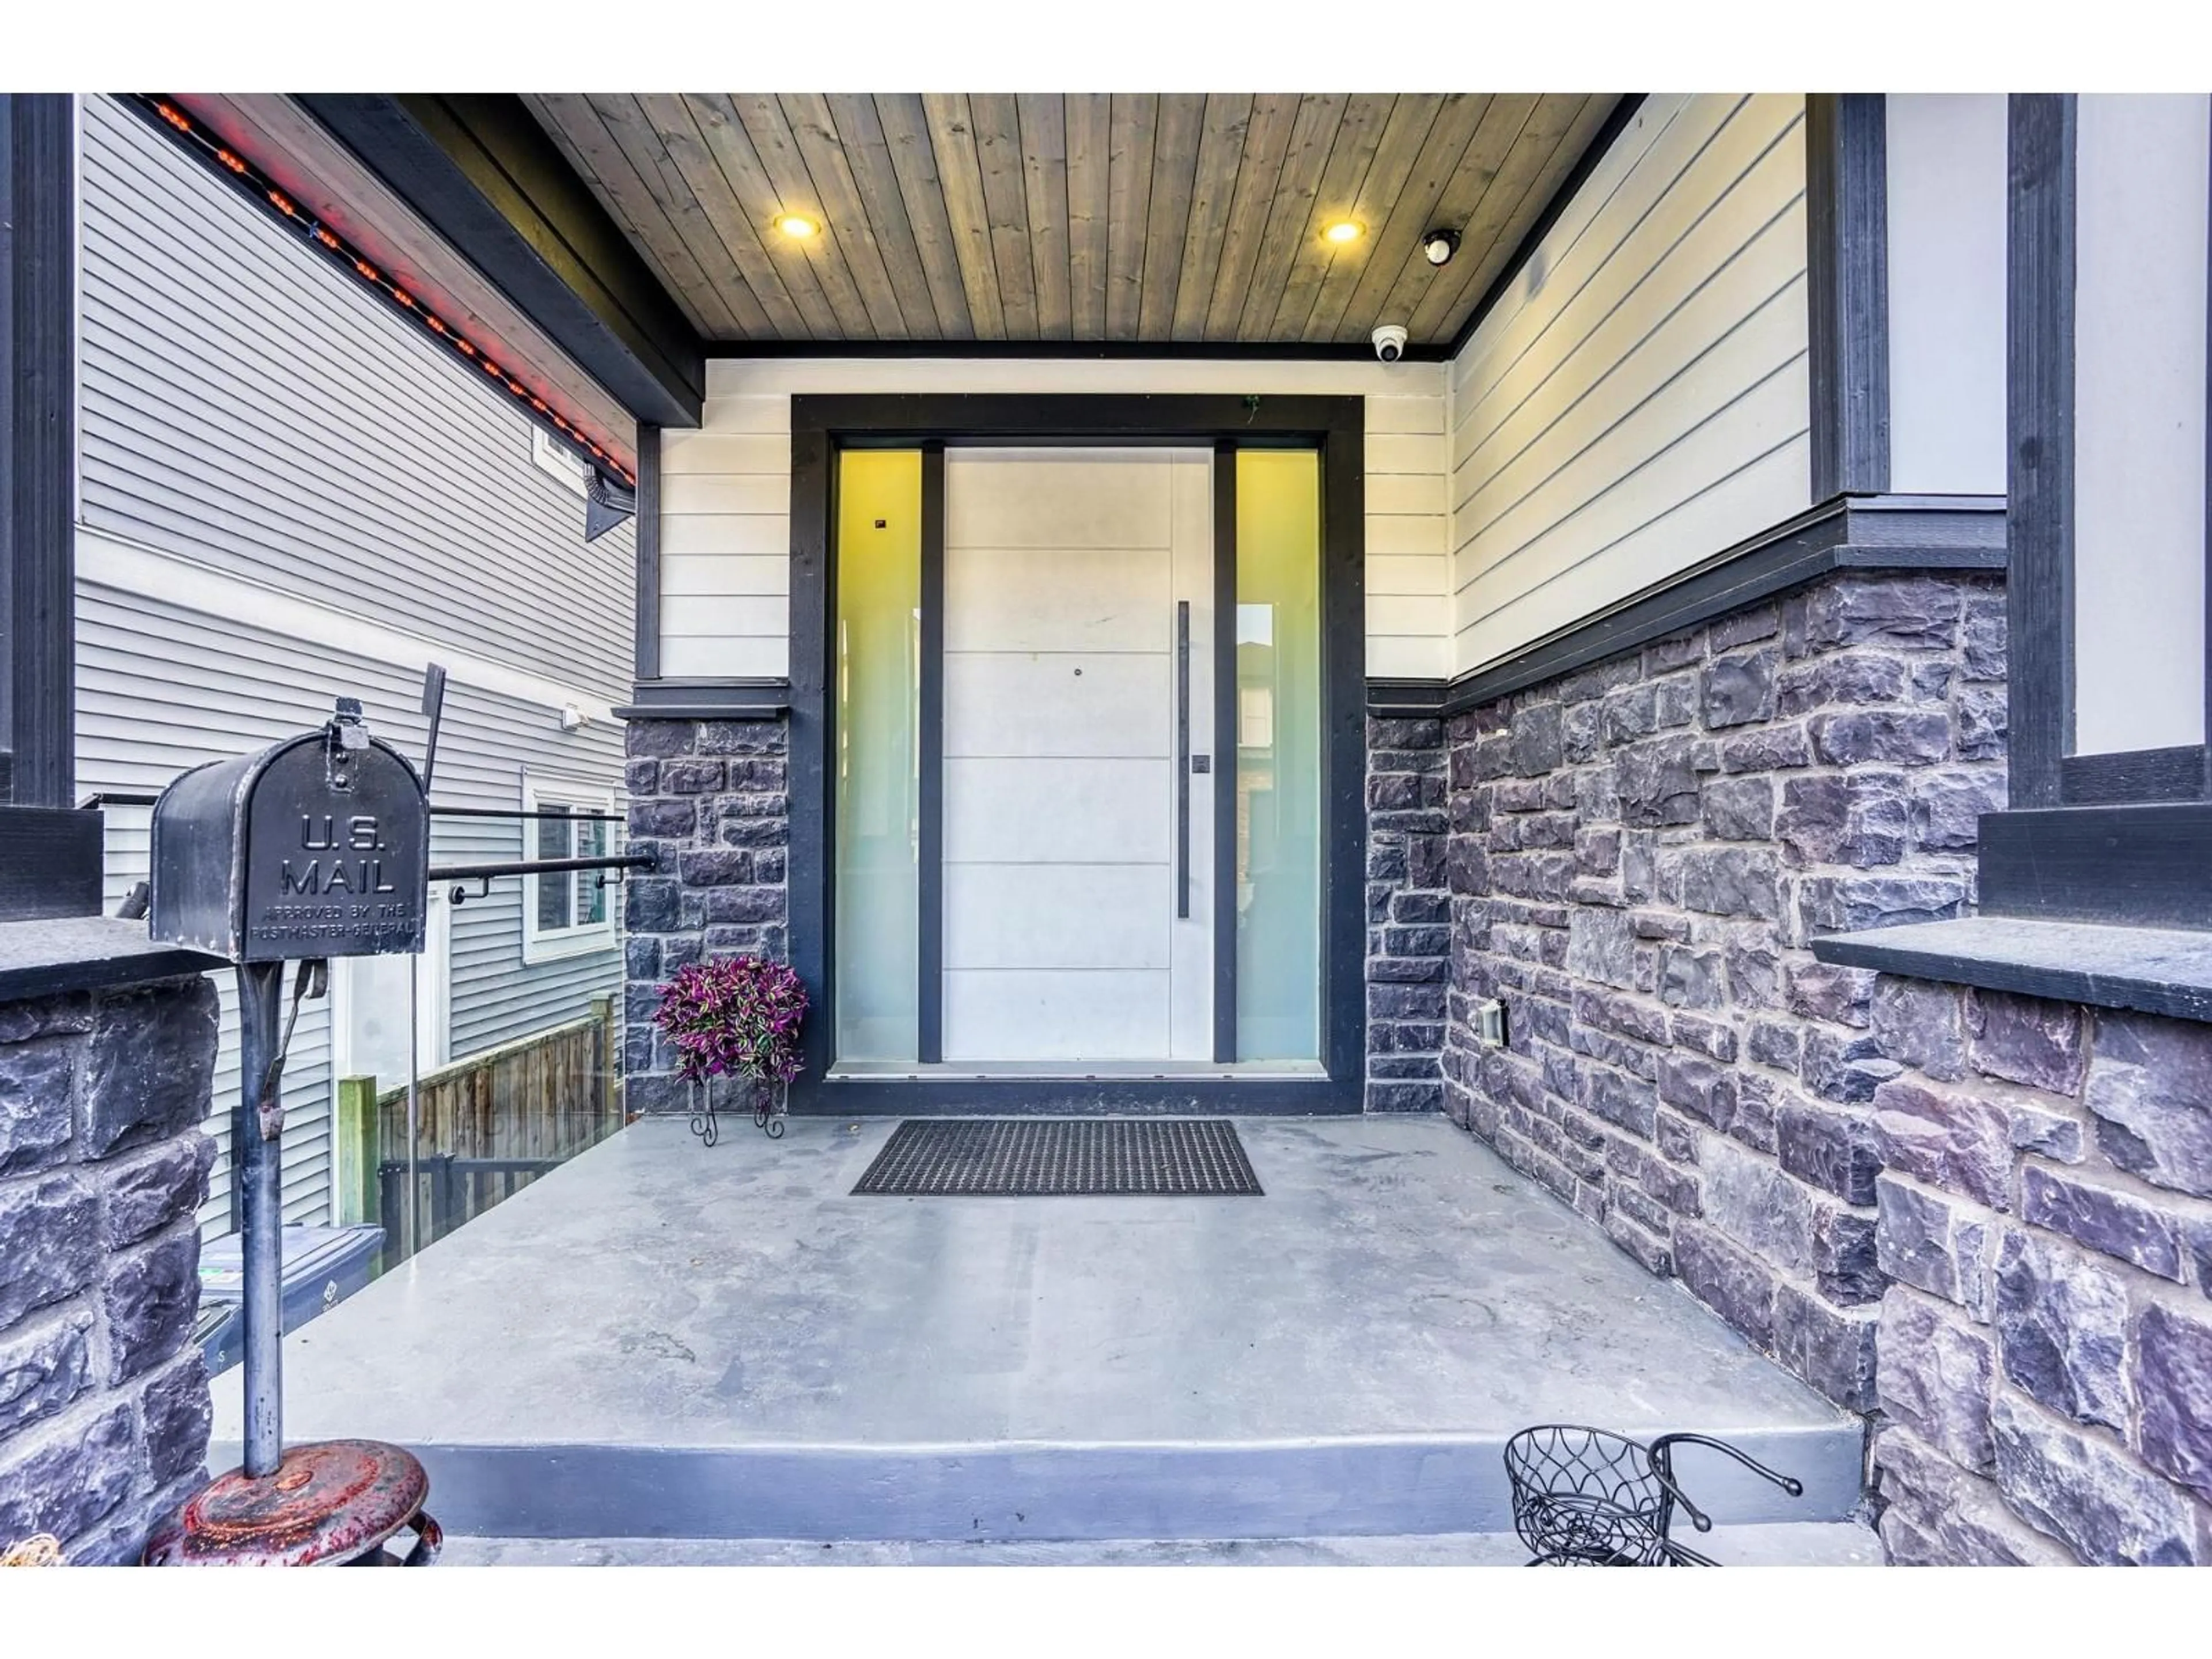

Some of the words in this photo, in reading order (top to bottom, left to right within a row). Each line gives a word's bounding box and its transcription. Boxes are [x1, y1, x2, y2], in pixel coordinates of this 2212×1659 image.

[301, 813, 387, 851] U.S.
[281, 859, 395, 894] MAIL
[262, 905, 343, 921] APPROVED
[350, 904, 370, 918] BY
[377, 902, 407, 918] THE
